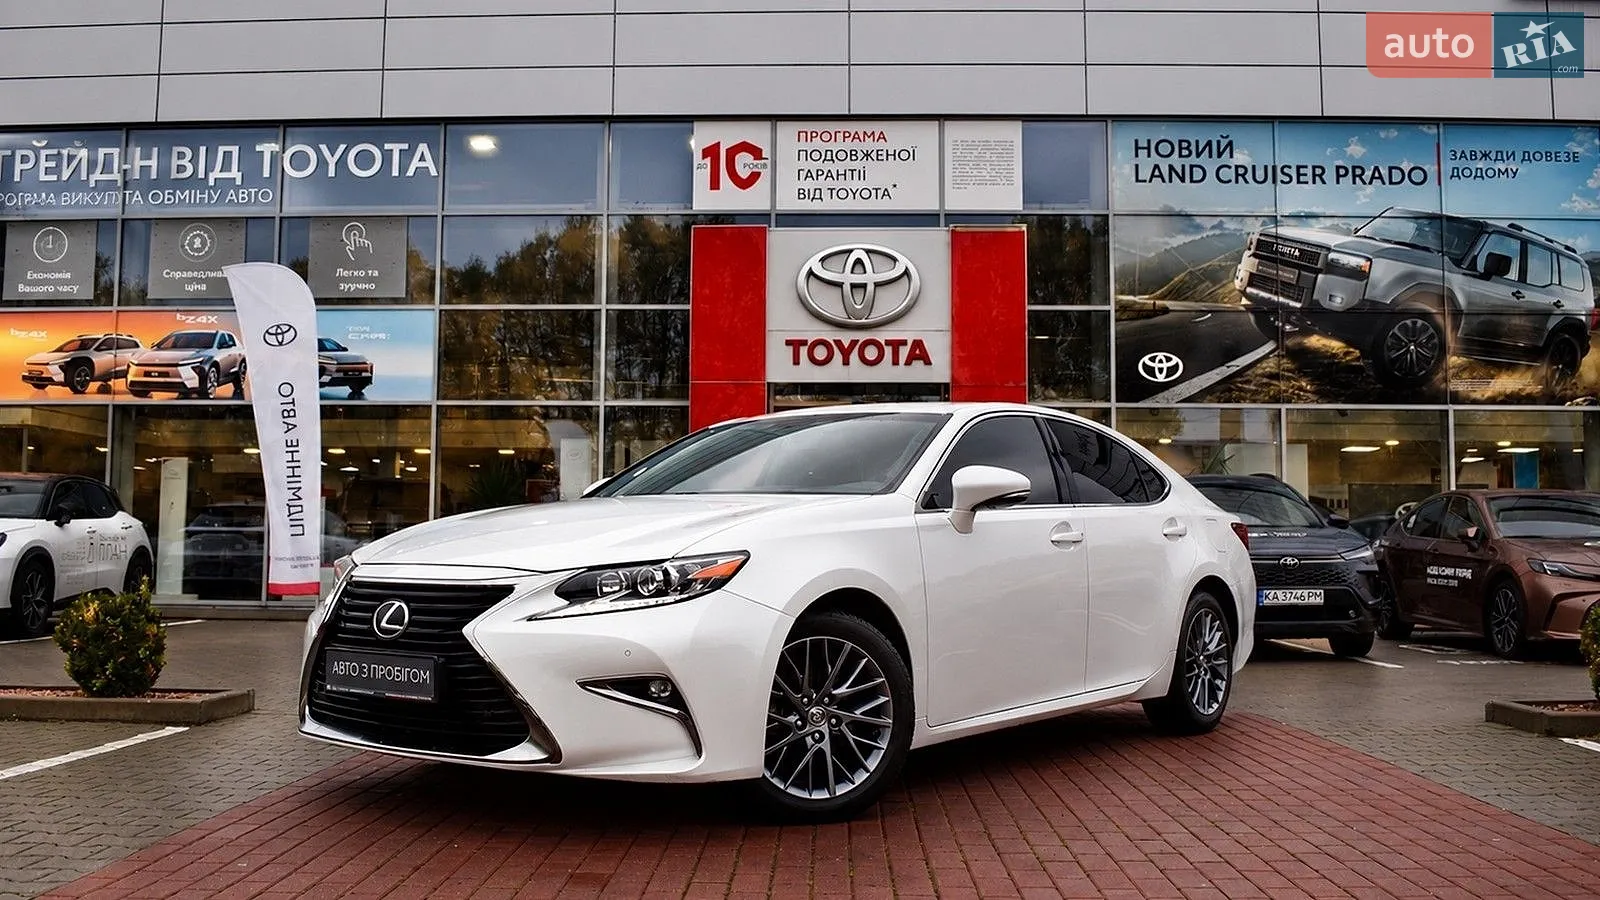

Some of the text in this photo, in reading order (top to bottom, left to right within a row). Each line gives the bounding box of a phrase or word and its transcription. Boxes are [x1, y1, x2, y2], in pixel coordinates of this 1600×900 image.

[797, 130, 888, 143] ПРОГРАМА
[797, 145, 918, 164] ПОДОВЖЕНОЇ
[1134, 134, 1234, 159] НОВИЙ
[170, 144, 242, 186] ВІД
[255, 142, 439, 178] TOYOTA
[1449, 149, 1580, 164] ЗАВЖДИ ДОВЕЗЕ
[1134, 163, 1428, 186] LAND CRUISER PRADO
[1450, 166, 1519, 181] ДОДОМУ
[124, 190, 143, 205] ТА
[148, 189, 221, 205] ОБМІНУ
[225, 188, 273, 203] АВТО
[797, 187, 824, 202] ВІД
[785, 338, 933, 366] TOYOTA
[277, 381, 305, 537] ПІДМІННЕ АВТО
[1264, 591, 1280, 602] KA
[1281, 590, 1306, 602] 3746
[332, 661, 430, 684] АВТО З ПРОБІГОМ
